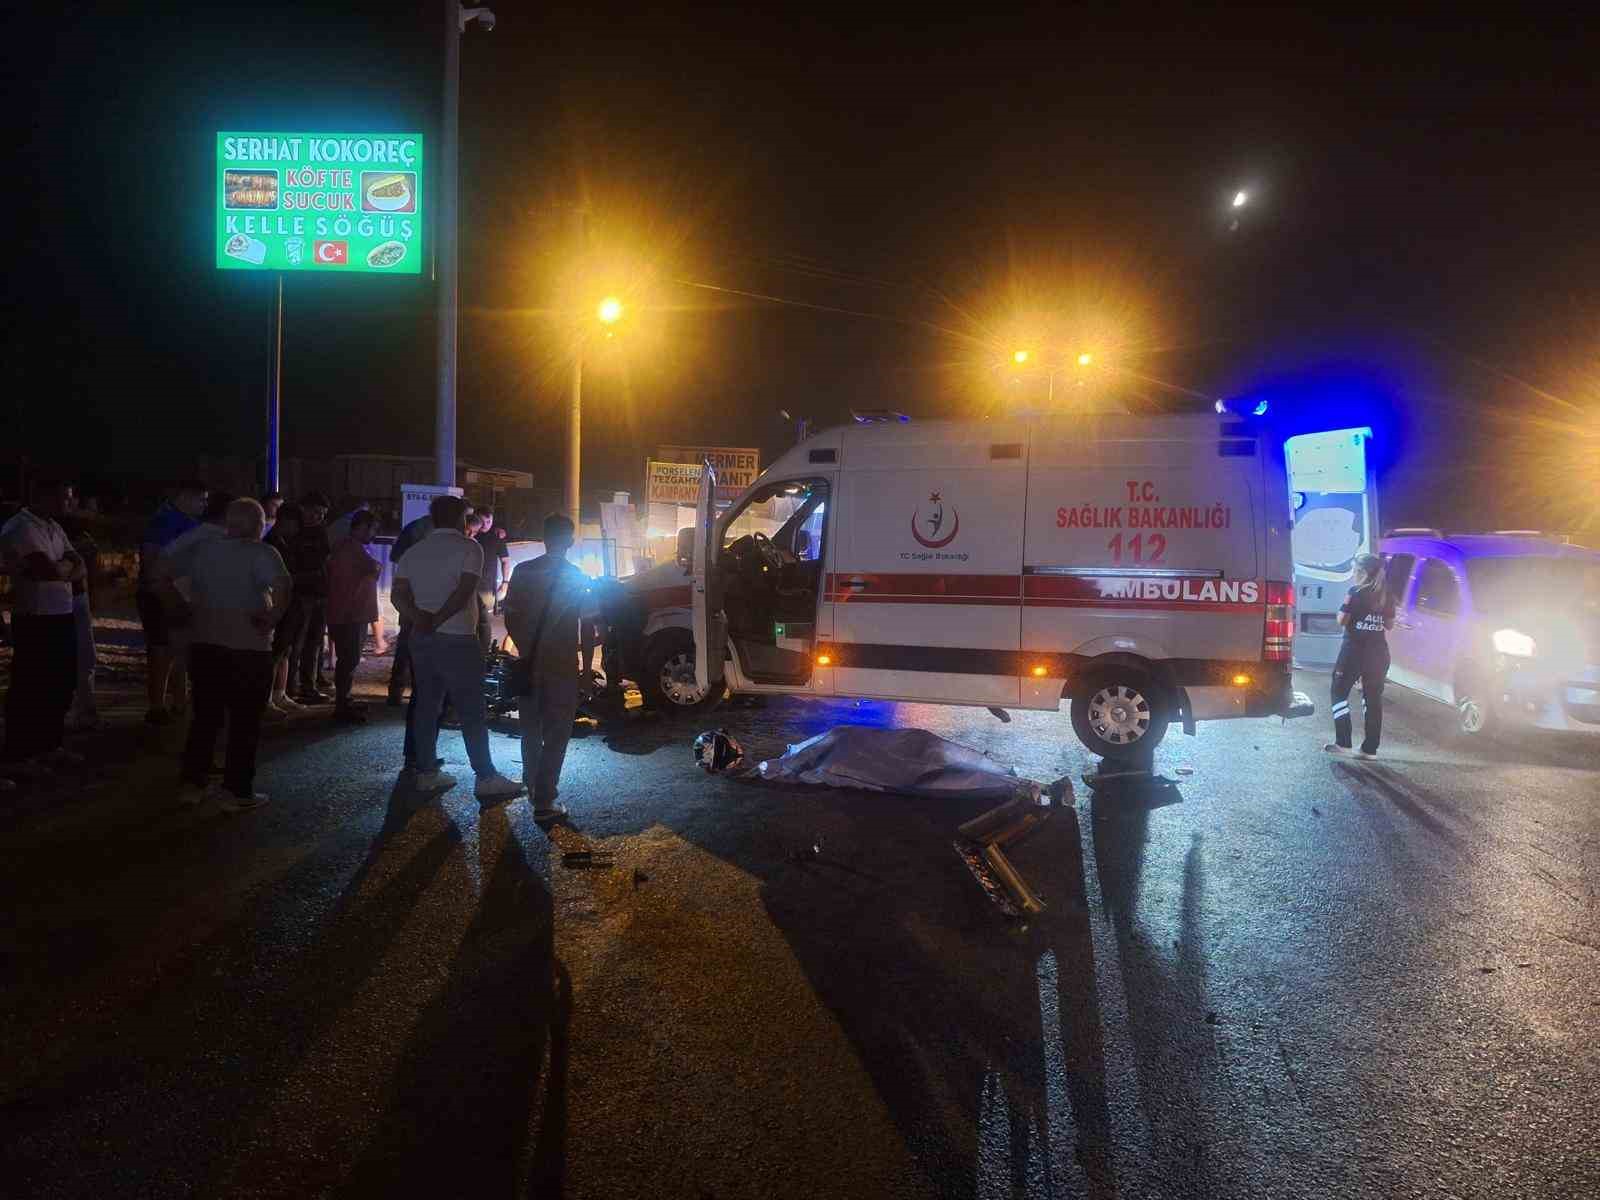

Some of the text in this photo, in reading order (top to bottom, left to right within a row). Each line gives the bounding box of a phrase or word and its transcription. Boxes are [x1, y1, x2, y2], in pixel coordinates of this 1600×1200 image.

[223, 136, 416, 167] SERHAT KOKOREÇ
[286, 166, 353, 189] KÖFTE
[284, 191, 355, 210] SUCUK
[225, 212, 413, 241] KELLE SÖĞÜŞ
[1126, 480, 1160, 502] T.C.
[1056, 497, 1231, 529] SAĞLIK BAKANLIĞI
[1107, 531, 1168, 567] 112
[1099, 578, 1259, 603] AMBULANS
